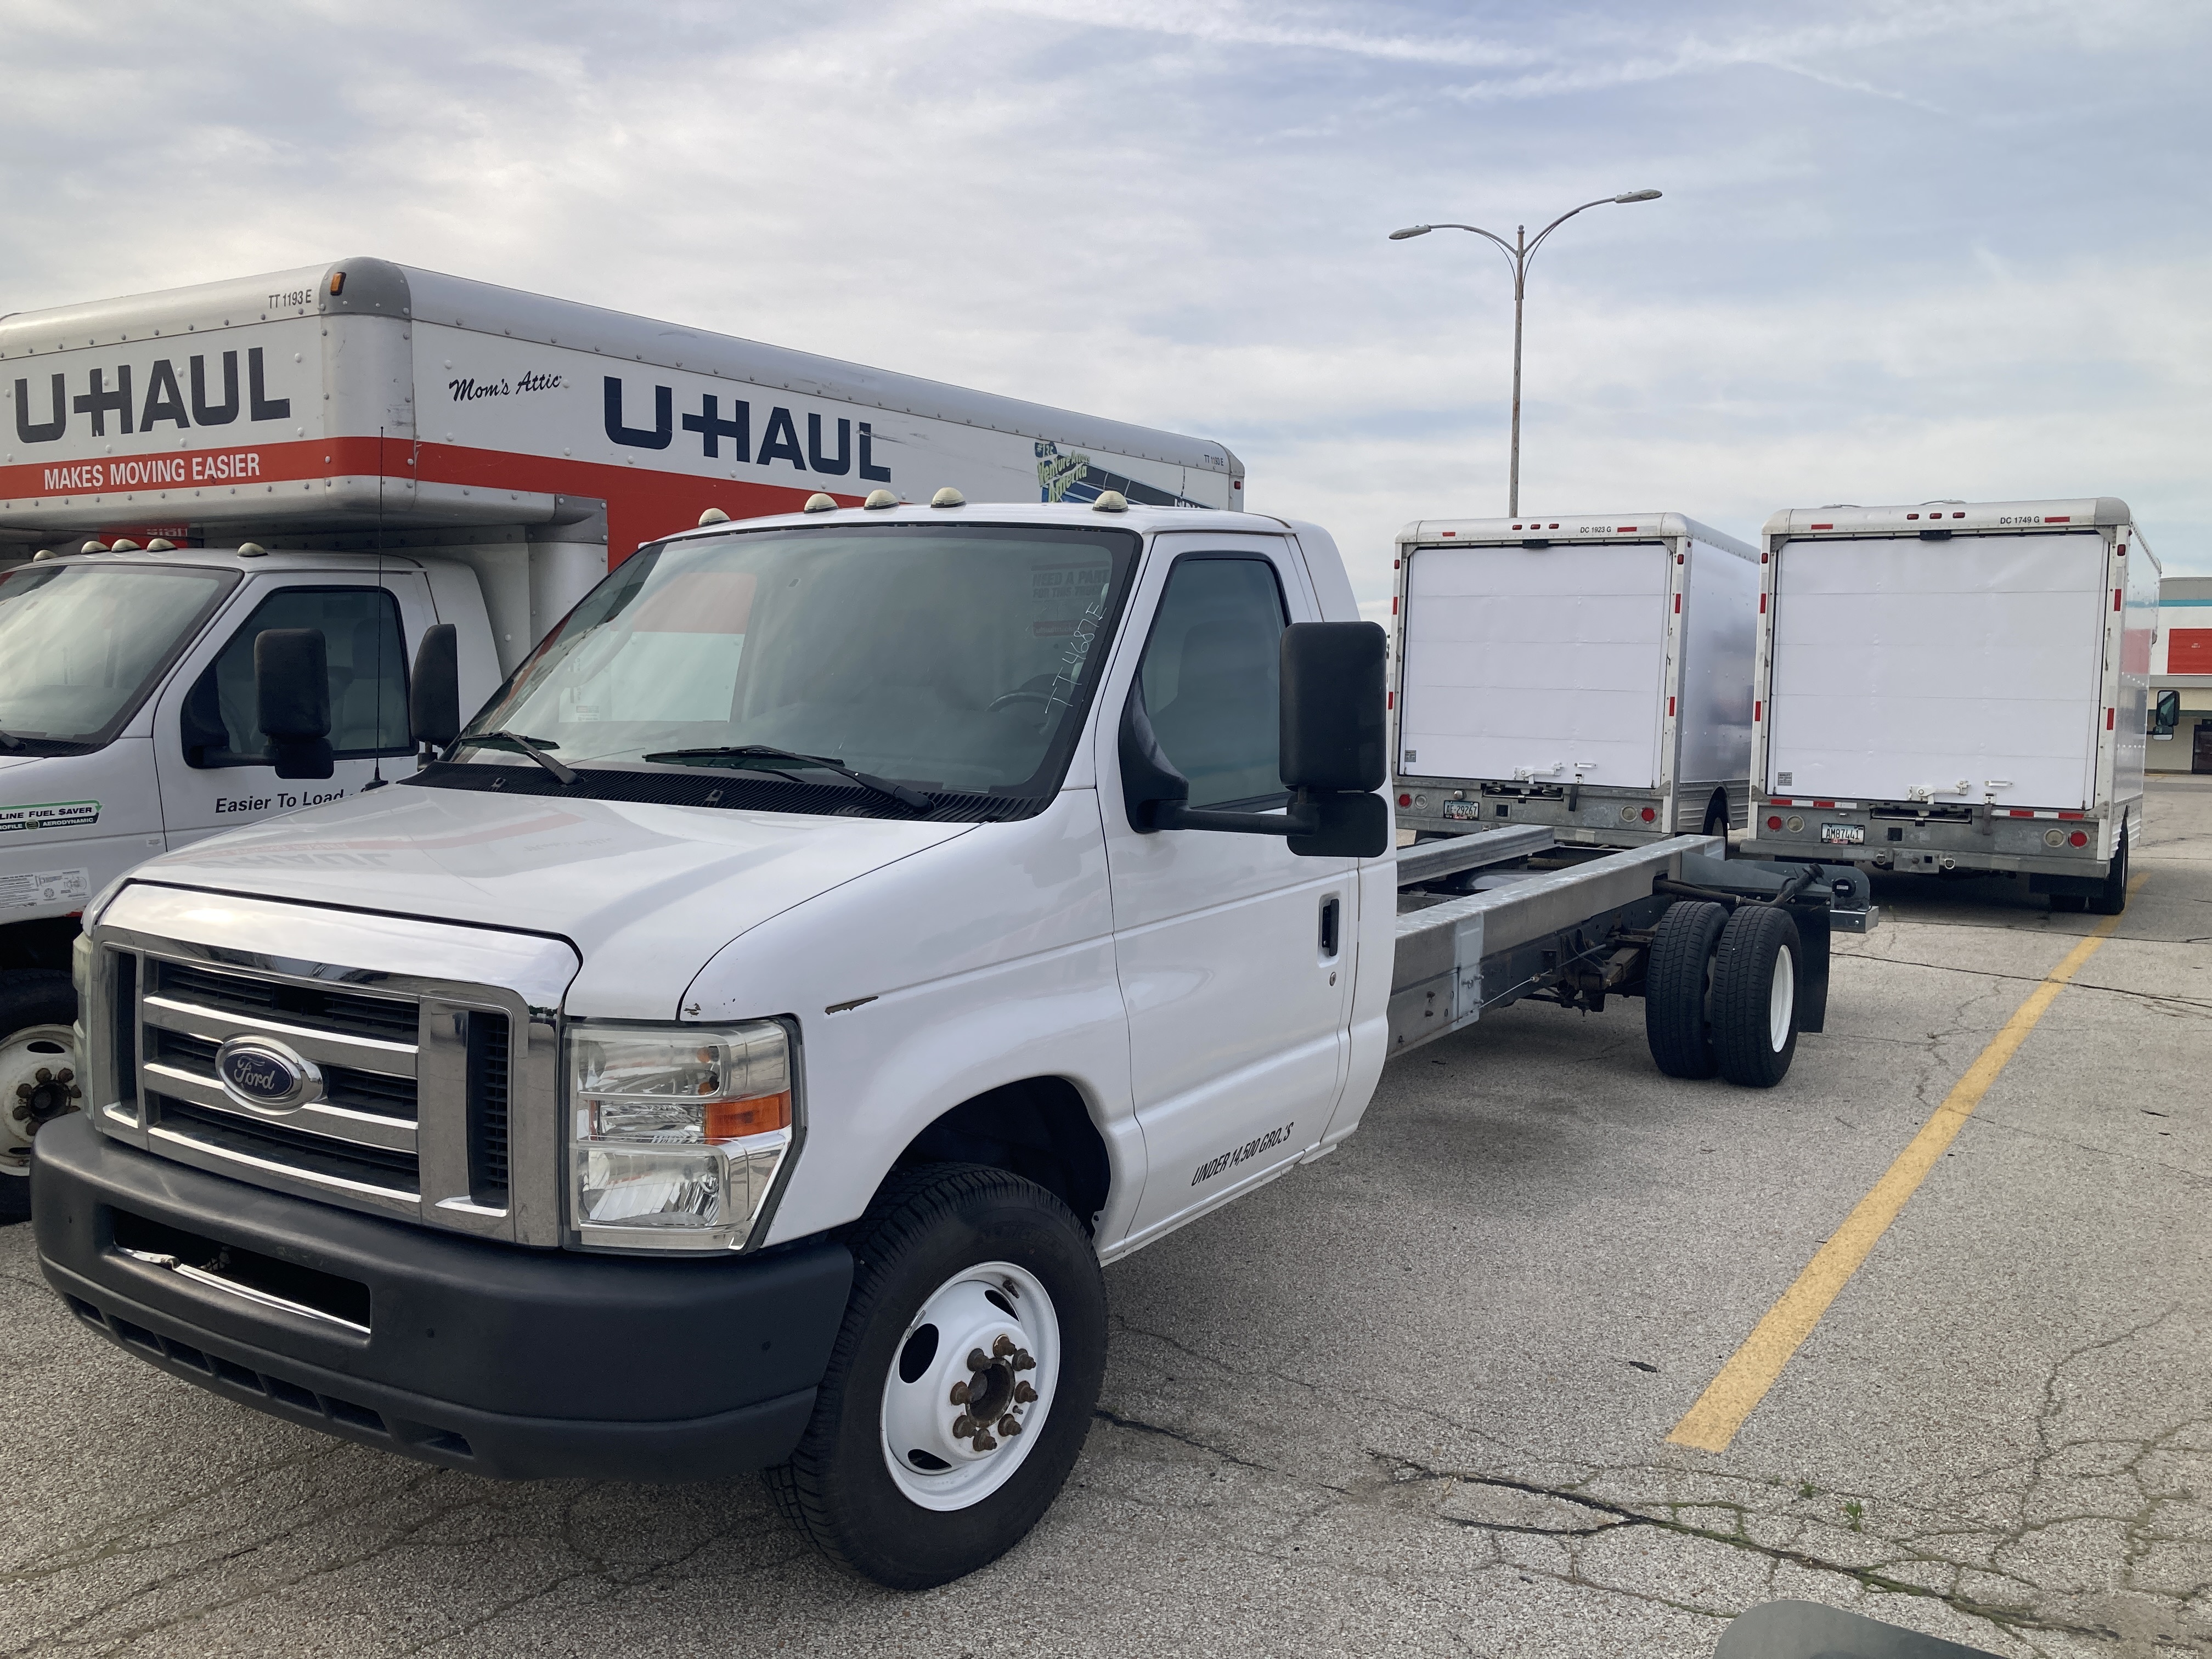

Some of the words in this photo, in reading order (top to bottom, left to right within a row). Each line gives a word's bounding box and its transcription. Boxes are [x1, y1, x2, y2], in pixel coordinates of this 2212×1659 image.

[269, 294, 280, 308] TT
[283, 290, 303, 307] 1193
[306, 289, 312, 303] E
[15, 347, 290, 443] U-HAUL
[449, 377, 511, 402] Mom's
[603, 376, 891, 483] U-HAUL
[1036, 443, 1053, 458] #135
[44, 464, 104, 490] MAKES
[109, 458, 185, 486] MOVING
[191, 453, 260, 481] EASIER
[1037, 455, 1071, 487] Venture
[29, 810, 55, 818] FUEL
[58, 807, 92, 816] SAVER
[215, 795, 272, 814] Easier
[277, 793, 297, 808] To
[42, 817, 94, 827] AERODYNAMIC
[1826, 828, 1860, 840] AM87441
[233, 1055, 275, 1090] Ford
[1191, 1151, 1231, 1187] UNDER
[1228, 1137, 1261, 1169] 14,500
